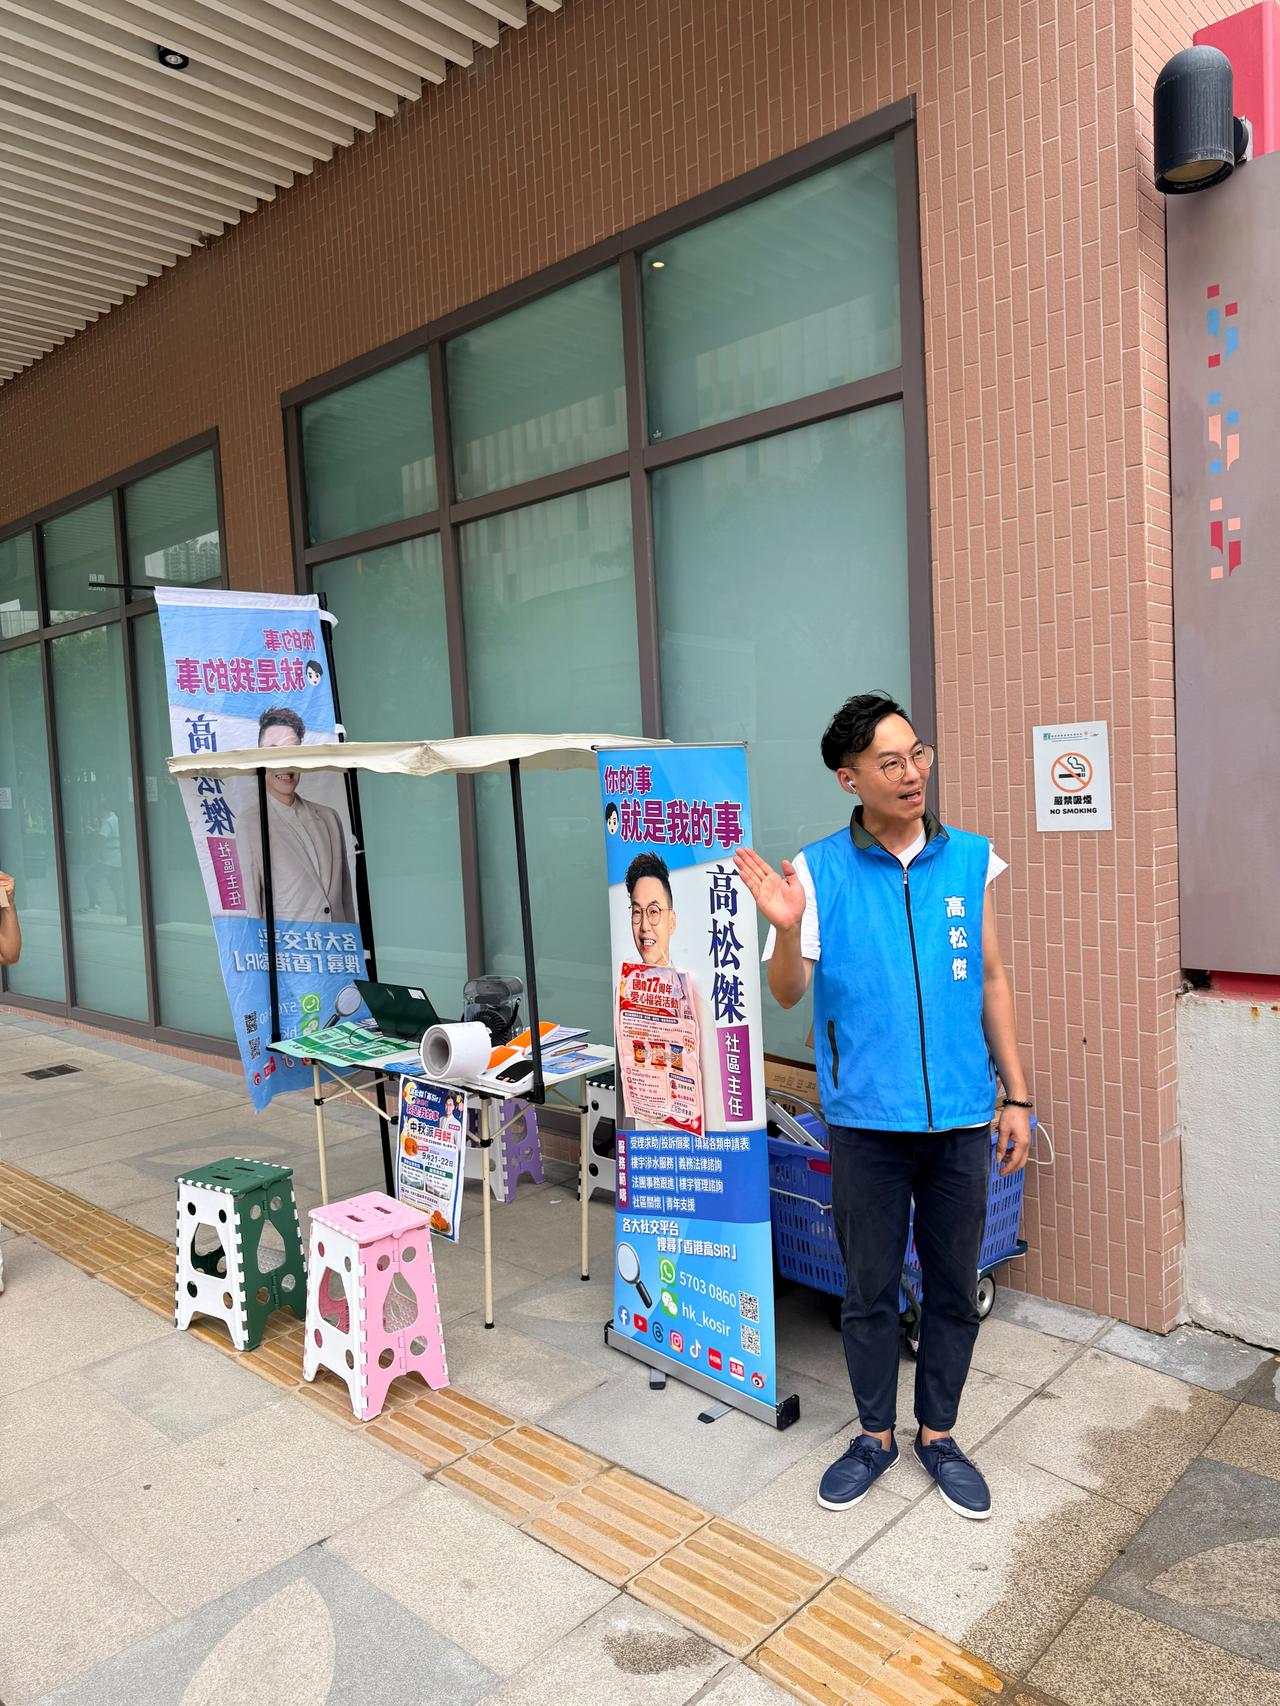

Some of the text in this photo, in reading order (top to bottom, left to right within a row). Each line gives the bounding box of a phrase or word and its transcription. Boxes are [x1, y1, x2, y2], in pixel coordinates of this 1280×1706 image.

[604, 765, 652, 795] 你的事
[1053, 795, 1093, 806] 嚴禁吸煙
[1062, 807, 1098, 815] SMOKING
[620, 799, 743, 849] 就是我的事
[706, 864, 747, 1024] 高松傑
[944, 896, 968, 981] 高松傑
[630, 991, 678, 1009] 愛心福袋活動
[725, 1033, 744, 1117] 社區主任
[410, 1121, 452, 1143] 中秋派月餅
[622, 1218, 679, 1236] 各大社交平台
[657, 1237, 737, 1260] 搜尋「香港高SIR」
[679, 1272, 737, 1308] 5703 0860
[682, 1302, 732, 1337] hk_kosir
